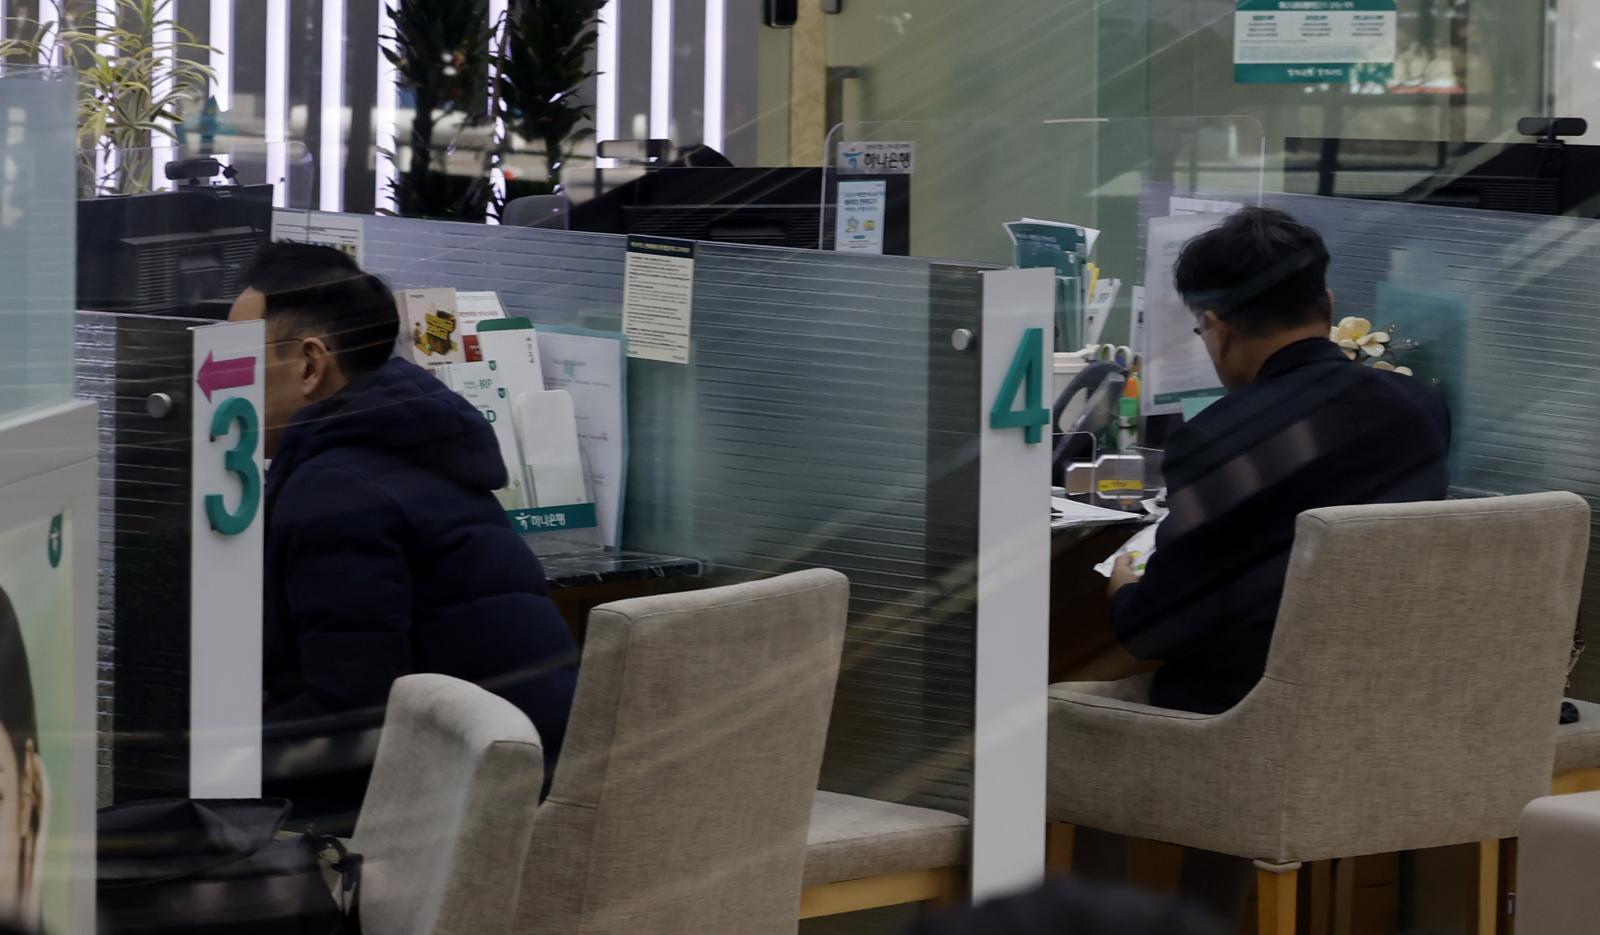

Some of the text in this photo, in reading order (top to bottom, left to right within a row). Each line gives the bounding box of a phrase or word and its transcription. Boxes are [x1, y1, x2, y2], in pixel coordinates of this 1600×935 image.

[864, 151, 911, 169] 하나은행
[989, 327, 1050, 444] 4
[205, 396, 261, 536] 3
[530, 512, 567, 528] 하나은행
